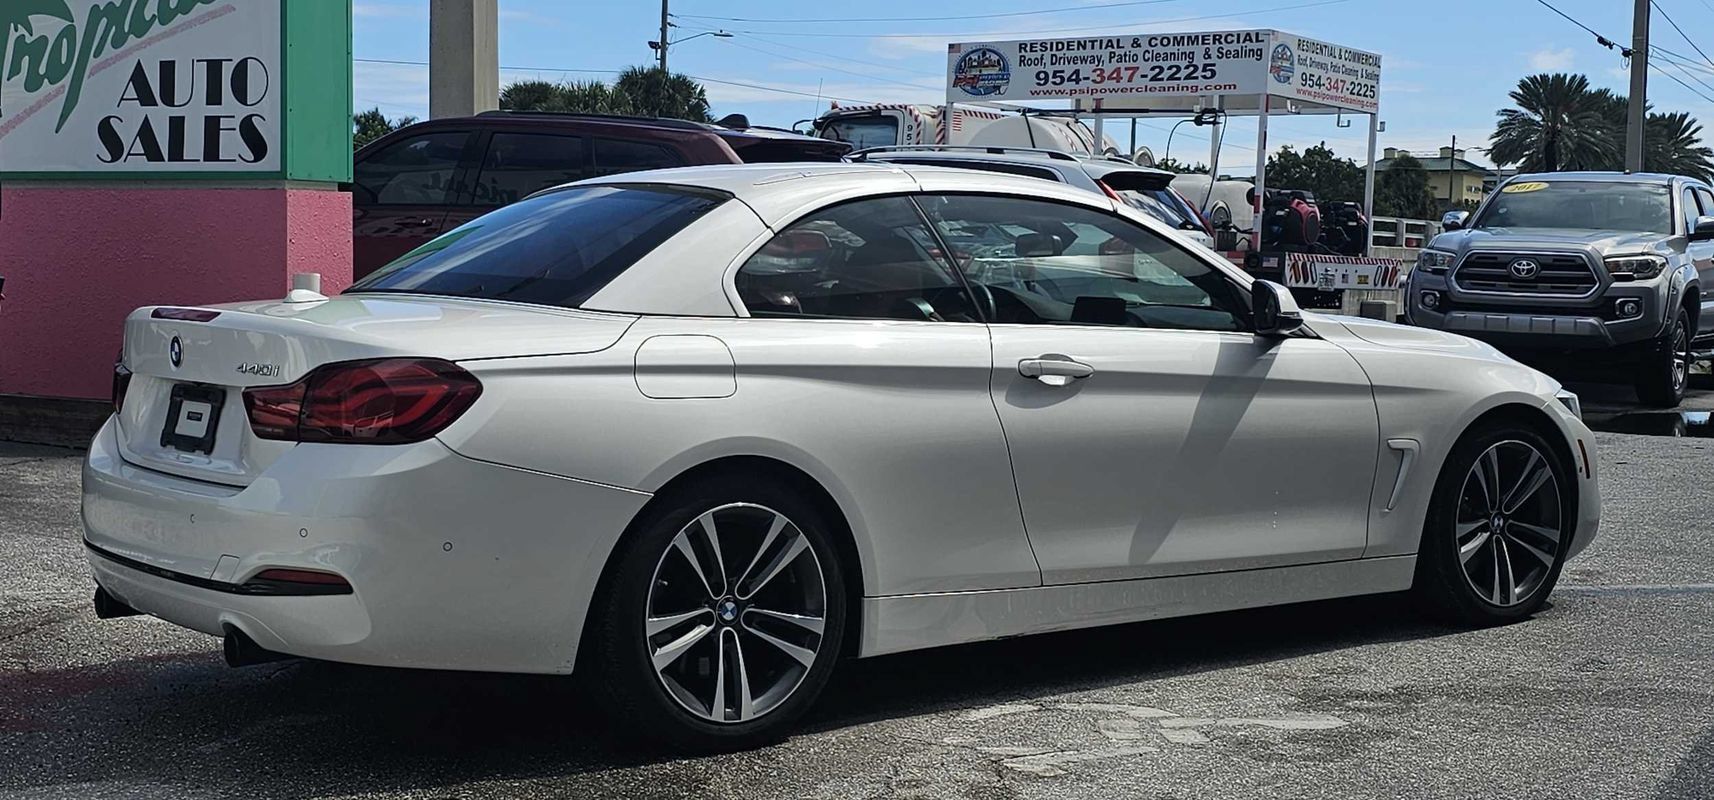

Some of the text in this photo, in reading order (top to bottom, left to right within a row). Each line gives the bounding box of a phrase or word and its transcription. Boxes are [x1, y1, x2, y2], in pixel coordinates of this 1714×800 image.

[1018, 32, 1265, 54] RESIDENTIAL & COMMERCIAL
[1297, 38, 1337, 59] RESIDENTIAL
[1344, 49, 1381, 69] COMMERCIAL
[0, 0, 216, 134] ropic
[1018, 45, 1263, 69] Roof, Driveway, Patio Cleaning & Sealing
[117, 56, 269, 108] AUTO
[1034, 63, 1217, 87] 954-347-2225
[1300, 71, 1376, 99] 954-347-2225
[1029, 83, 1237, 96] www.psipowercleaning.com
[96, 113, 268, 164] SALES
[236, 361, 280, 377] 440i
